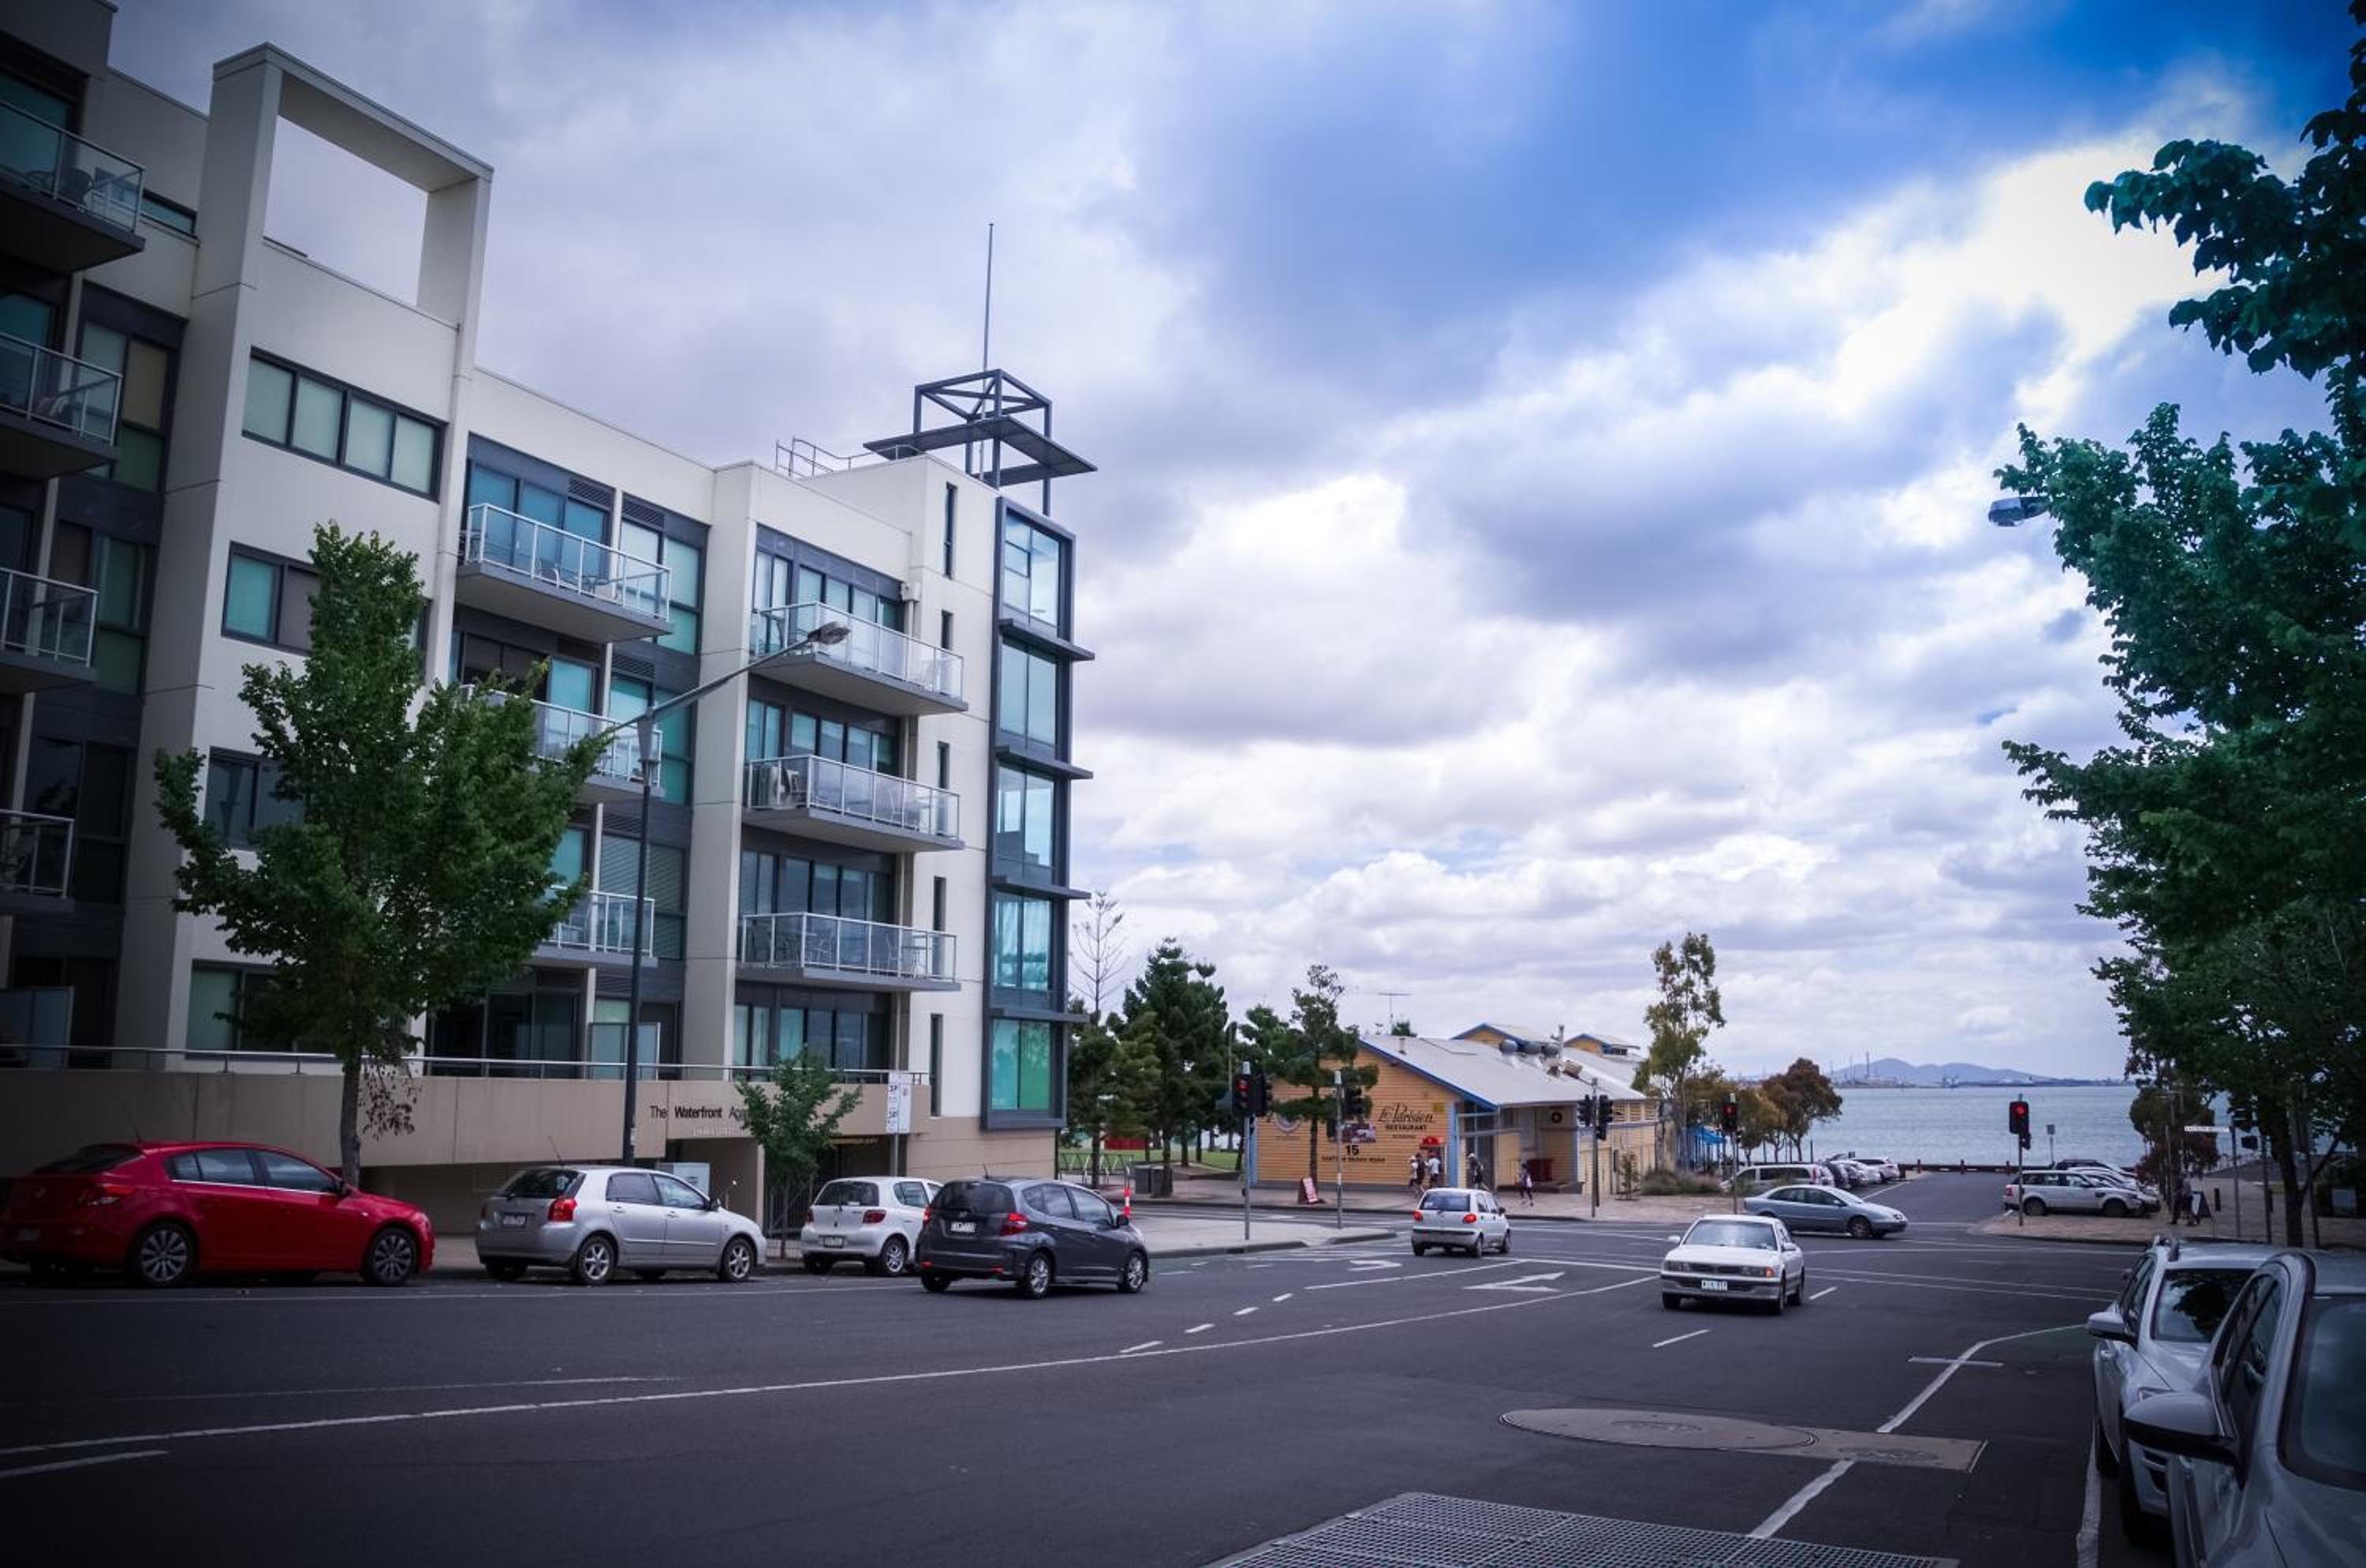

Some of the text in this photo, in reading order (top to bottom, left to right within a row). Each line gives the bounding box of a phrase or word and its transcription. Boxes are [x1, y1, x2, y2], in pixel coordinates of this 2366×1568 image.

[650, 1105, 668, 1118] The
[674, 1105, 722, 1118] Waterfront
[1390, 1103, 1435, 1123] Parisien
[1345, 1144, 1359, 1155] 15
